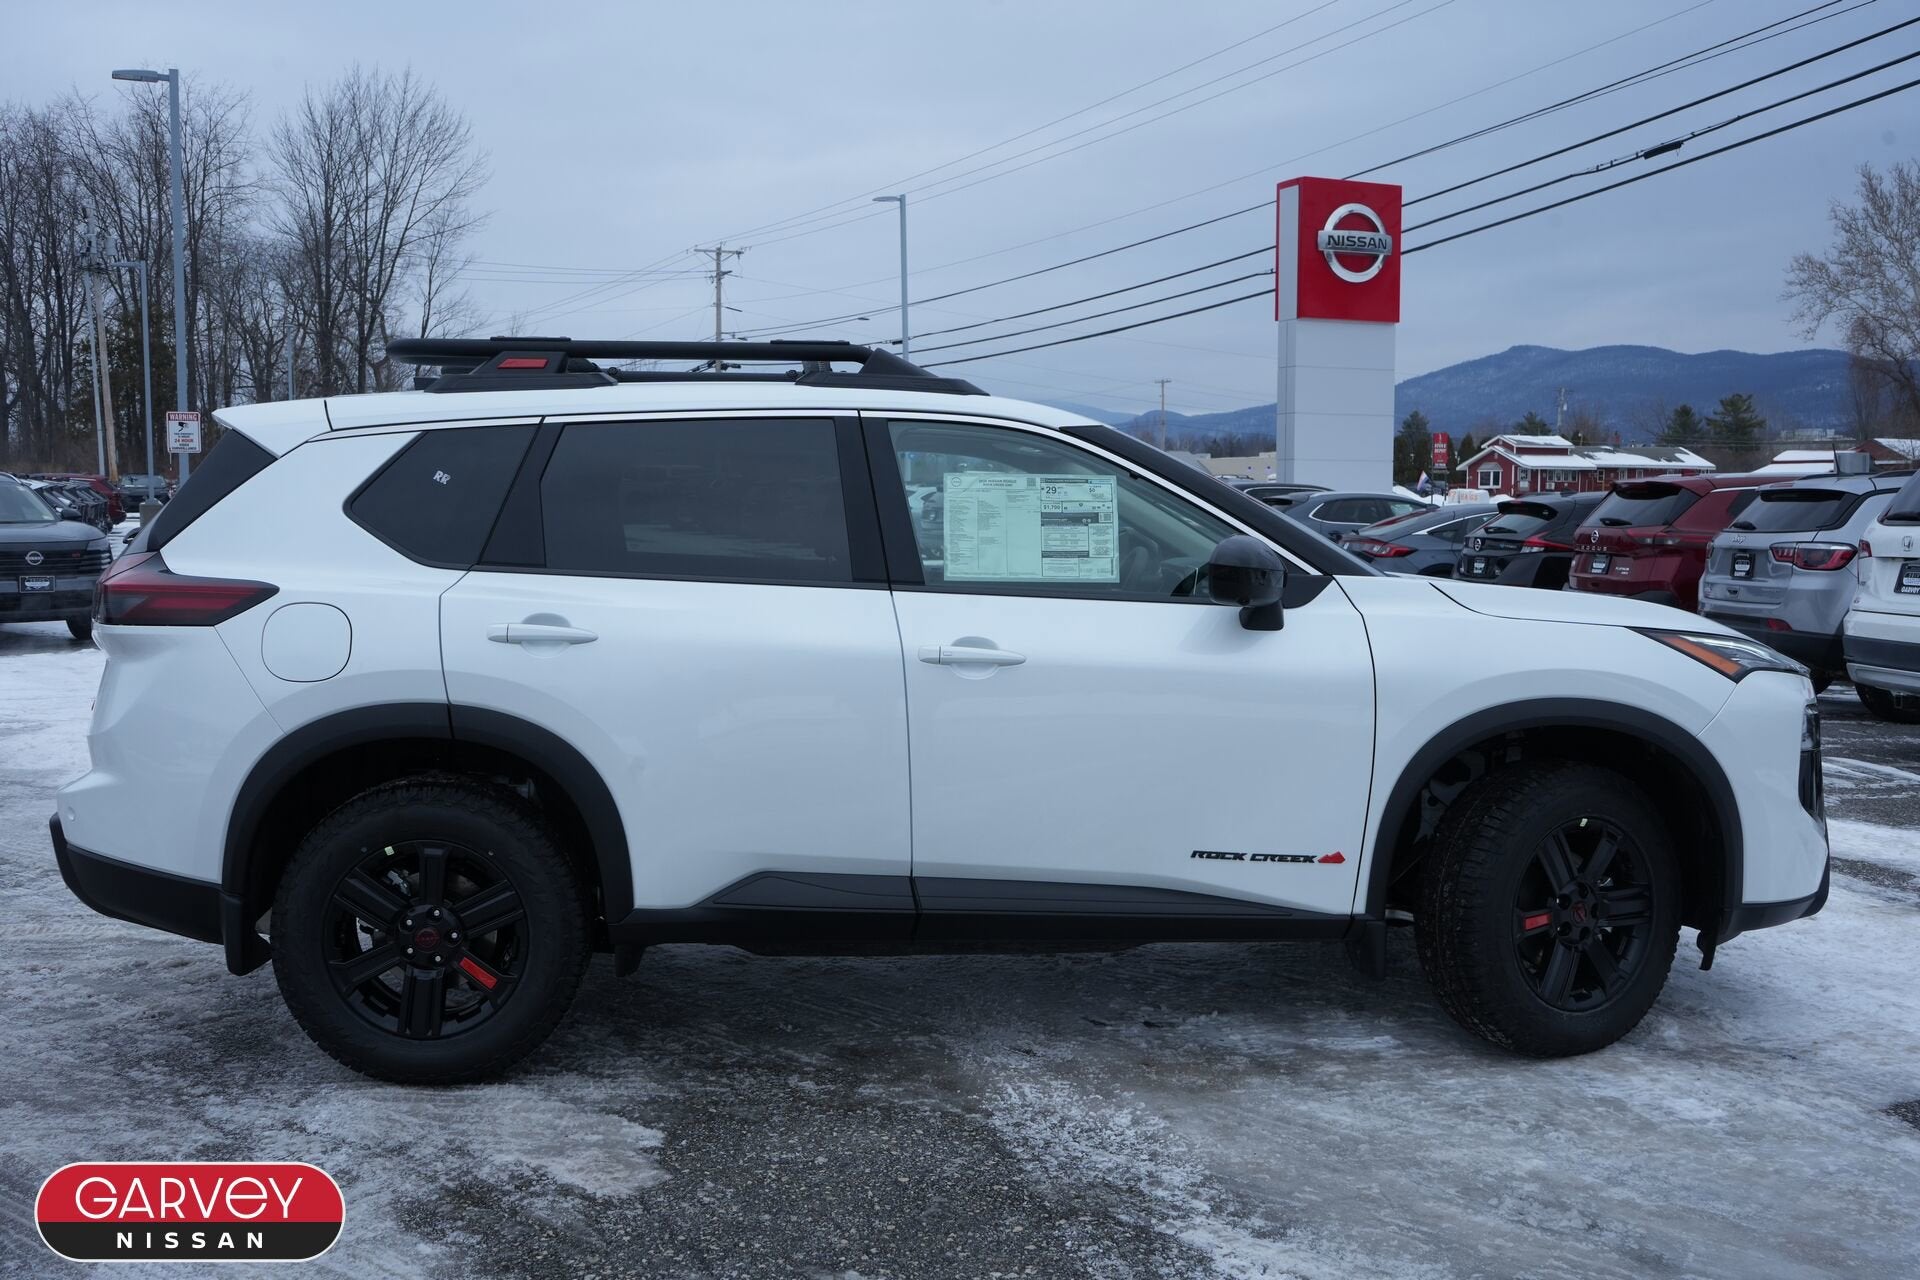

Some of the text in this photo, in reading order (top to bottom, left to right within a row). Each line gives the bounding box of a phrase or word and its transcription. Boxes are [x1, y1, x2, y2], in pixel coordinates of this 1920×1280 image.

[1327, 235, 1387, 249] NISSAN
[170, 413, 198, 421] WARNING
[1046, 486, 1057, 495] 29
[1190, 850, 1318, 864] ROCK CREEK
